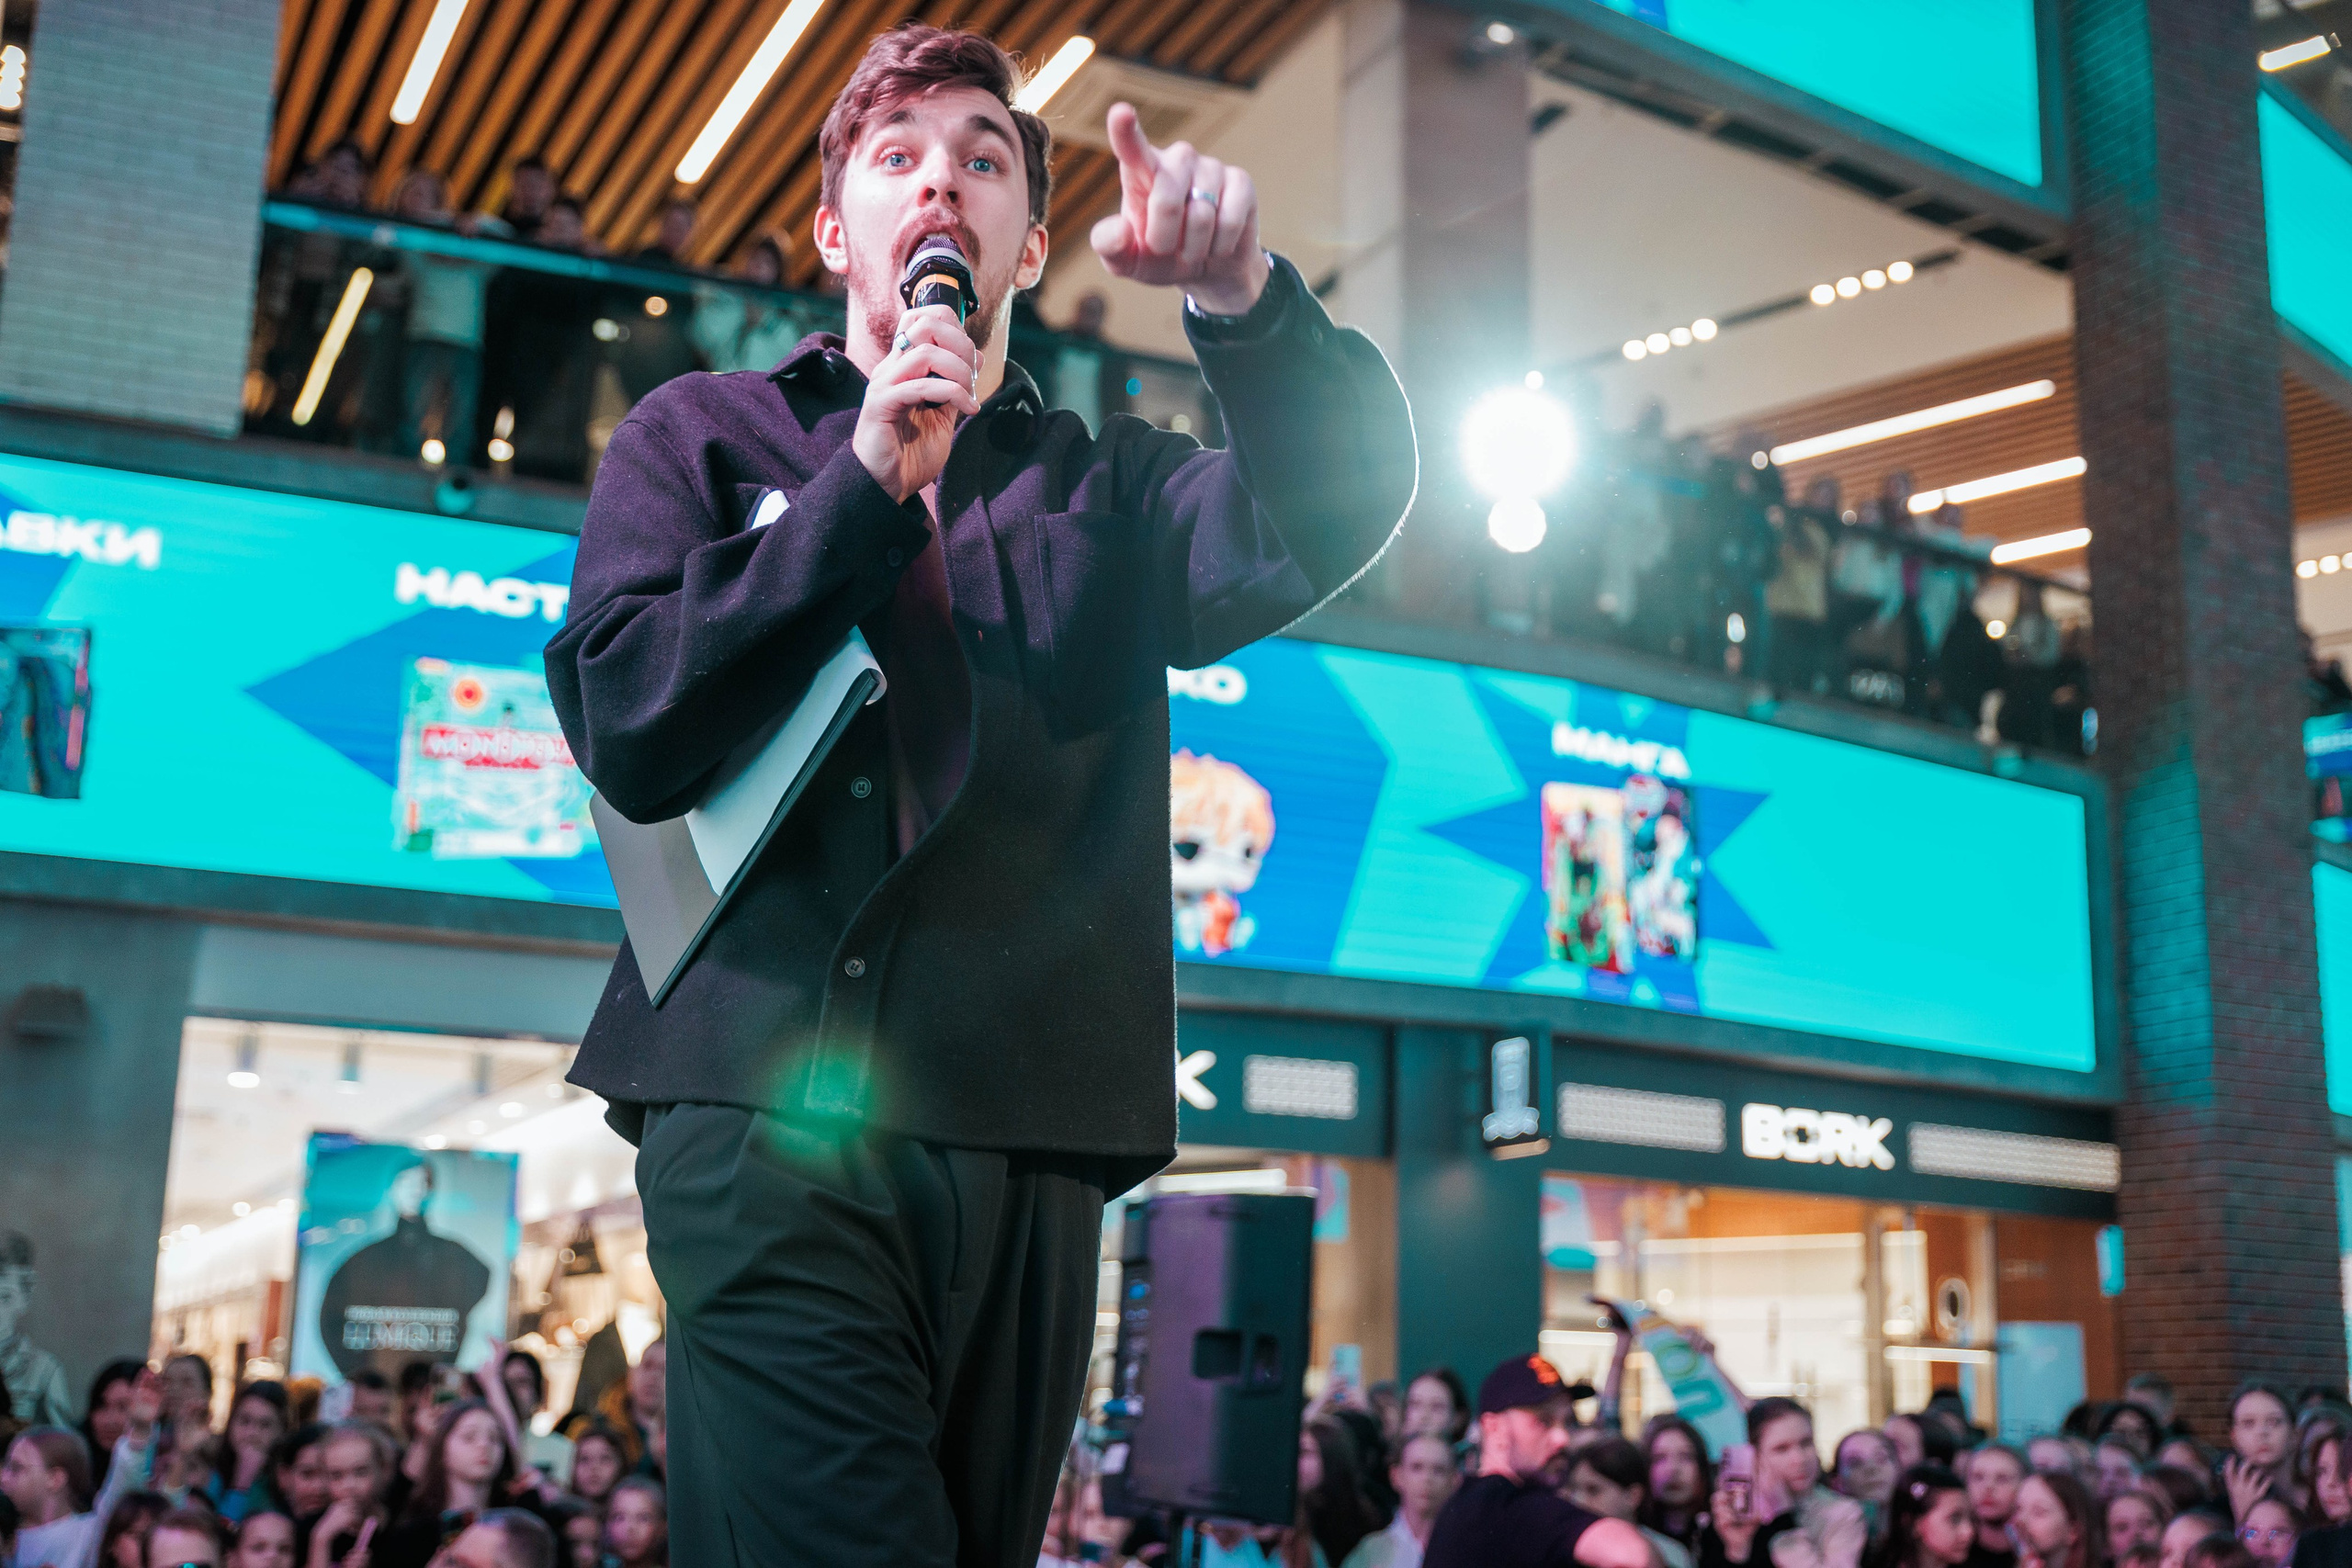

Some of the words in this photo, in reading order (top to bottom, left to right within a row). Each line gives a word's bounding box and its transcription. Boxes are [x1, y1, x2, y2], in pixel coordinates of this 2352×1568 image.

[0, 509, 163, 570] ВКИ
[1551, 720, 1692, 780] МАНГА
[1741, 1102, 1896, 1170] BORK
